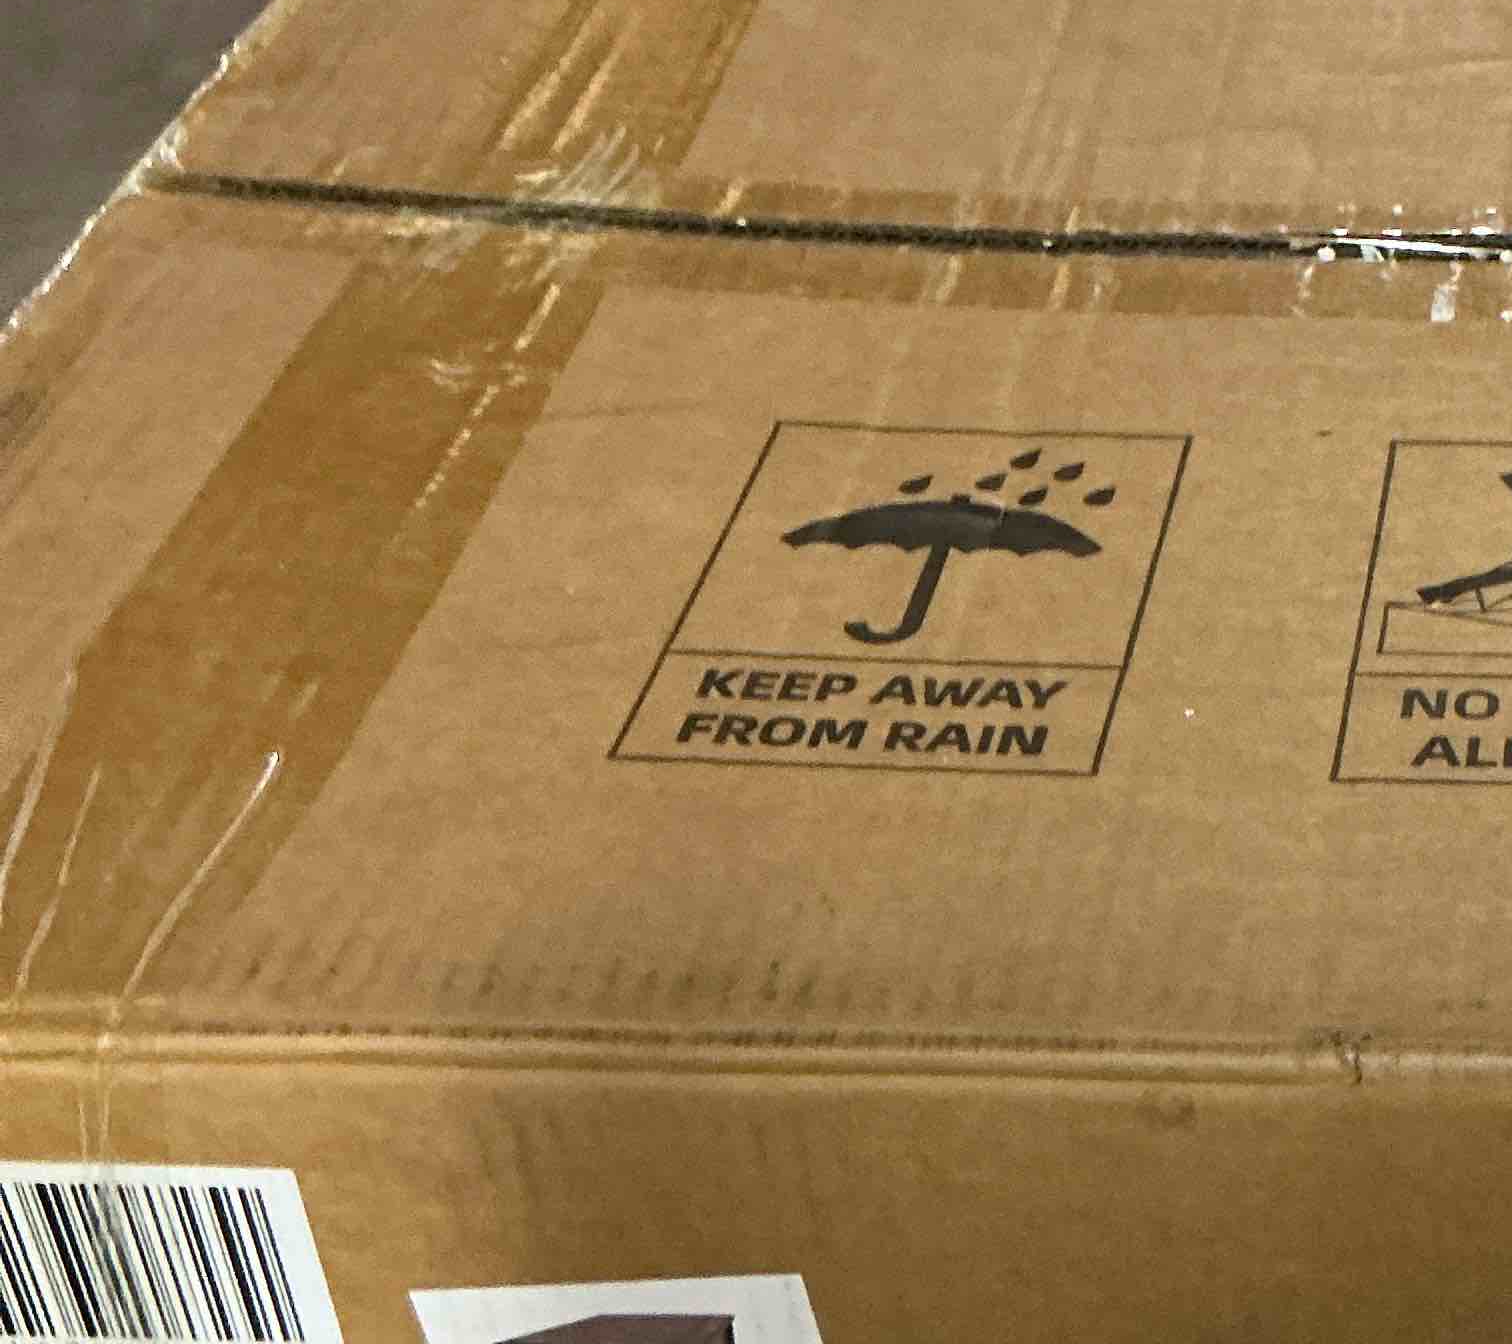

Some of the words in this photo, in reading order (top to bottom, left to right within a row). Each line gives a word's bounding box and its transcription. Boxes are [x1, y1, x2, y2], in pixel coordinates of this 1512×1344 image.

[697, 669, 855, 704] KEEP
[871, 675, 1067, 710] AWAY
[1400, 689, 1499, 721] NO
[676, 713, 866, 750] FROM
[884, 721, 1048, 756] RAIN
